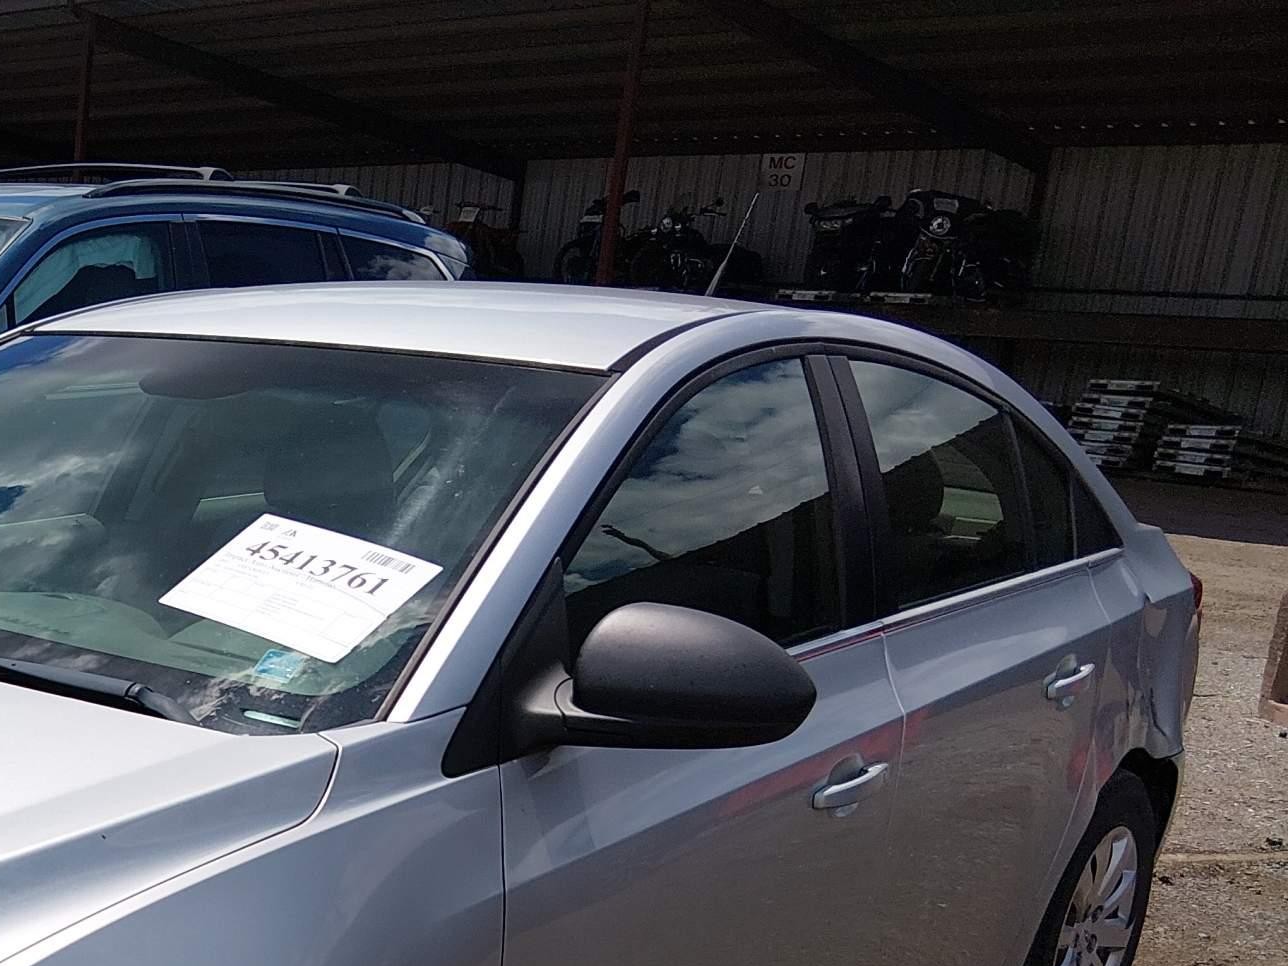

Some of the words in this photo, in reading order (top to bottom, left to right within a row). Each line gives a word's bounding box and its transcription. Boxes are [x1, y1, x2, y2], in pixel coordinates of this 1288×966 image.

[768, 155, 797, 170] MC
[768, 173, 792, 188] 30
[245, 539, 390, 598] 45413761
